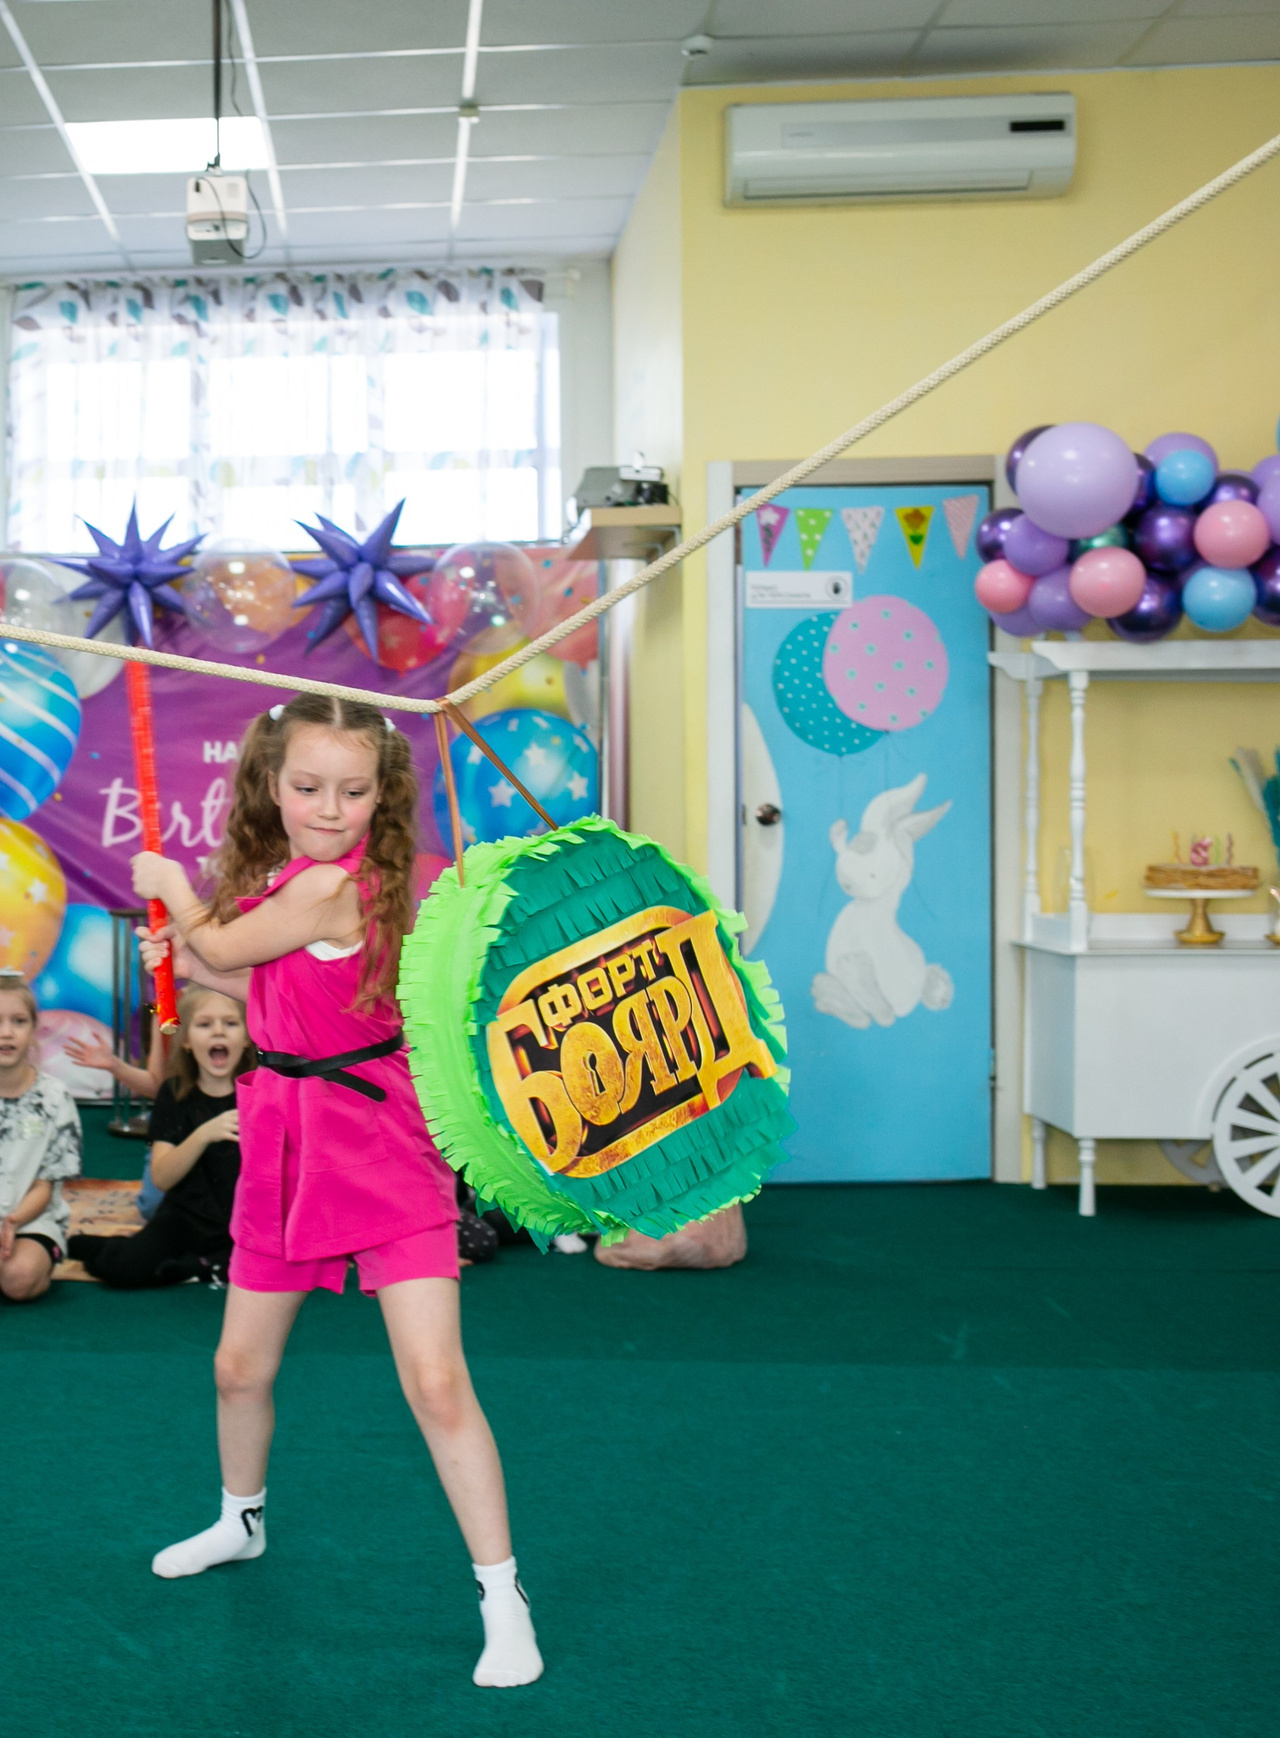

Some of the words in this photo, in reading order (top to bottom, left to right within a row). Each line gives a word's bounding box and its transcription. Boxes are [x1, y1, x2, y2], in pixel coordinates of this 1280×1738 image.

[202, 740, 240, 764] HA
[99, 777, 228, 848] Brt
[537, 939, 658, 1028] ФОРТ
[486, 910, 778, 1174] БОЯРД
